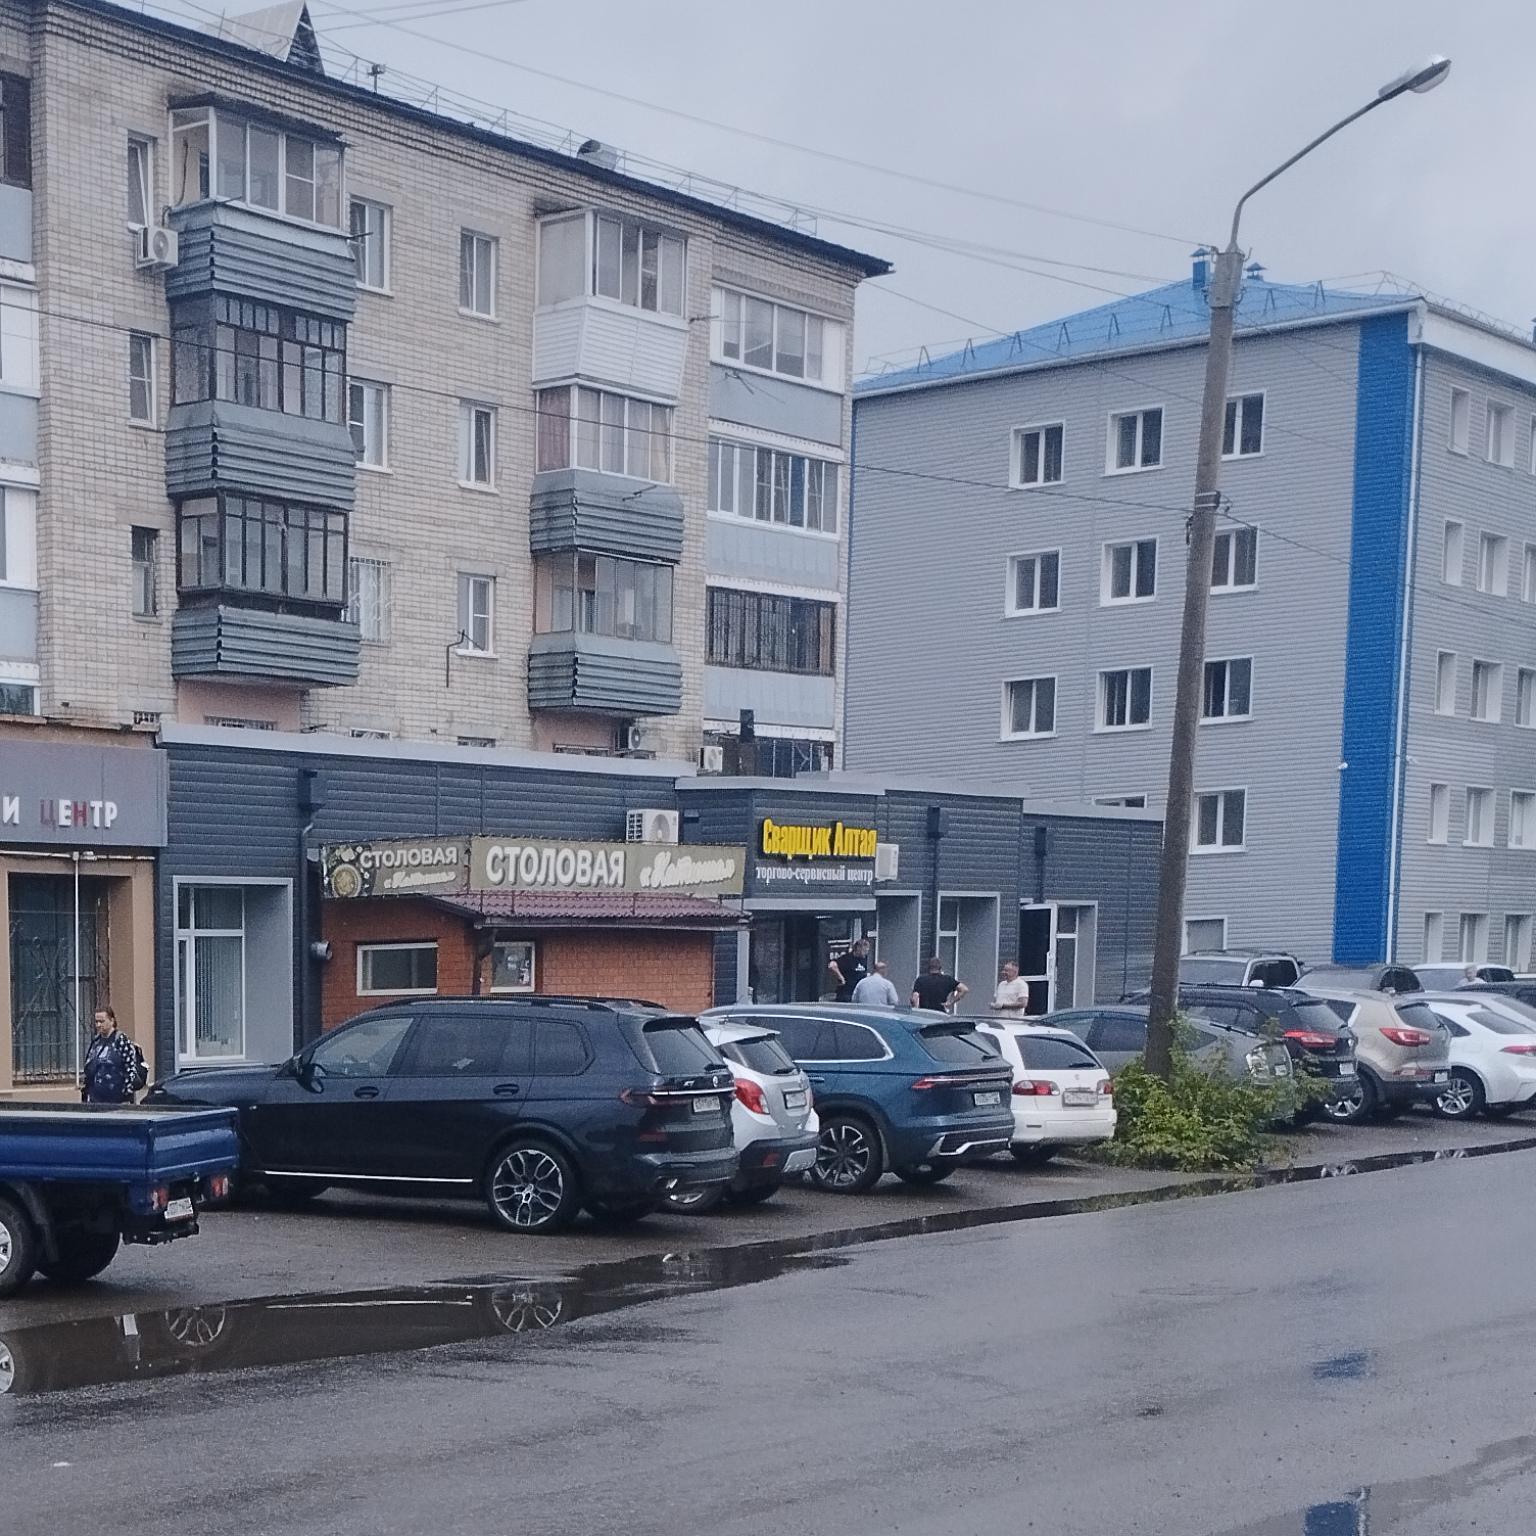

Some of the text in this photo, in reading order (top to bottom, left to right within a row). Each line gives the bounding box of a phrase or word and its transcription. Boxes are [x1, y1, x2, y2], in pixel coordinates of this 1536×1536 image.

[40, 799, 118, 831] ЦЕНТР
[763, 818, 878, 860] Сварщик Алтая
[360, 846, 458, 869] СТОЛОВАЯ
[485, 845, 626, 887] СТОЛОВАЯ
[755, 865, 873, 886] торгово-сервисный центр
